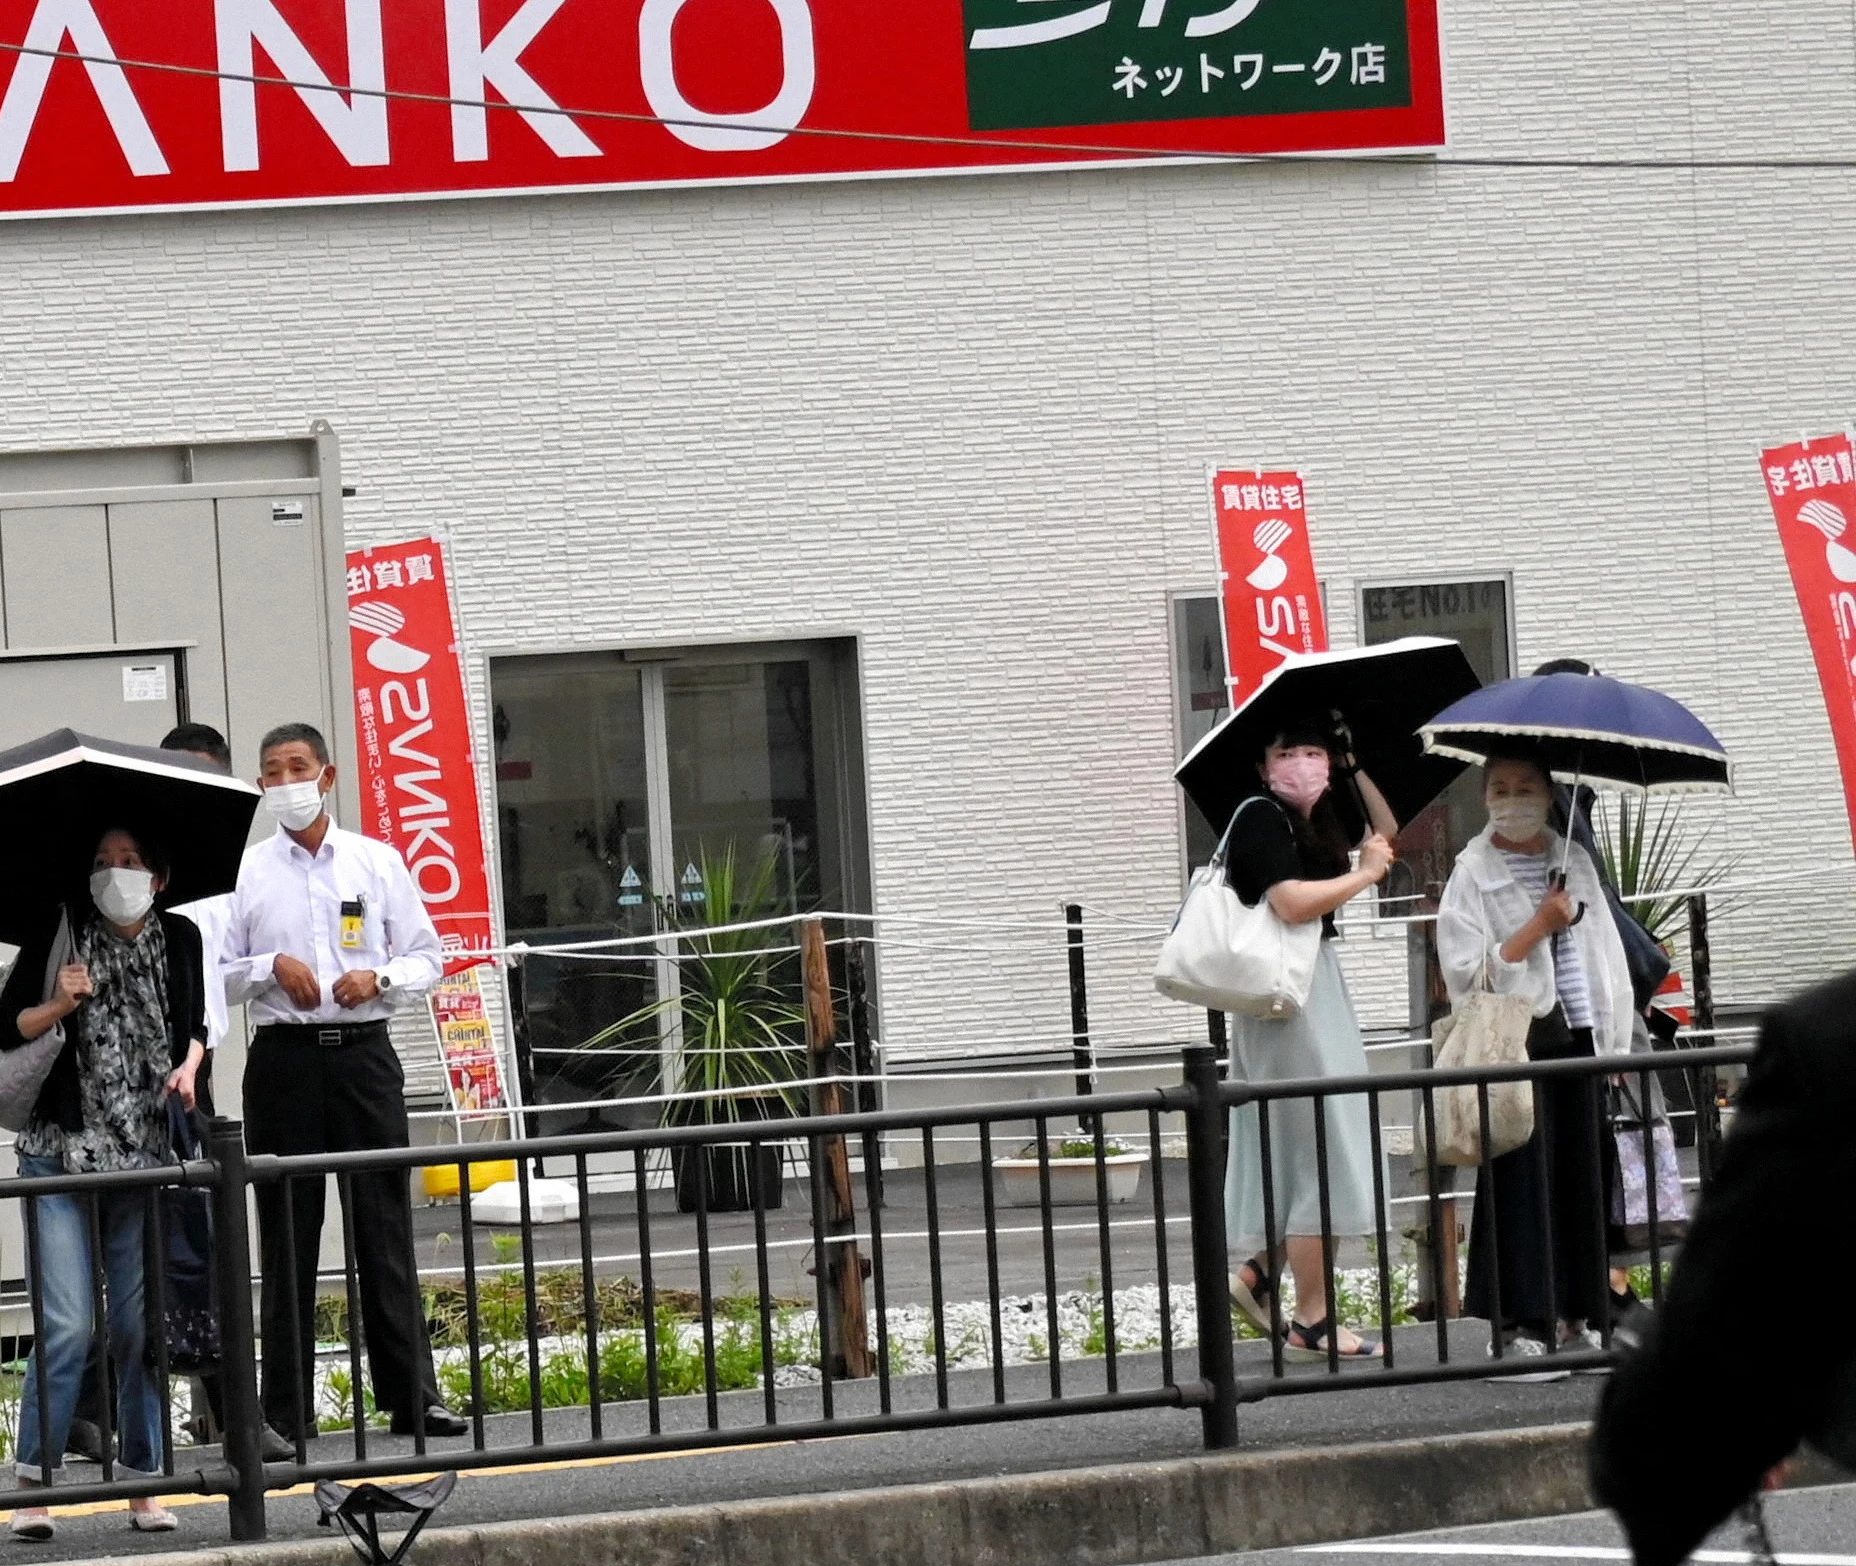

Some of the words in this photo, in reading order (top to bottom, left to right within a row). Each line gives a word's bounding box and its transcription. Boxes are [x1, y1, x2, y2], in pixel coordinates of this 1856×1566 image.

[1111, 42, 1386, 99] ネットワーク店
[1221, 484, 1303, 510] 賃貸住宅
